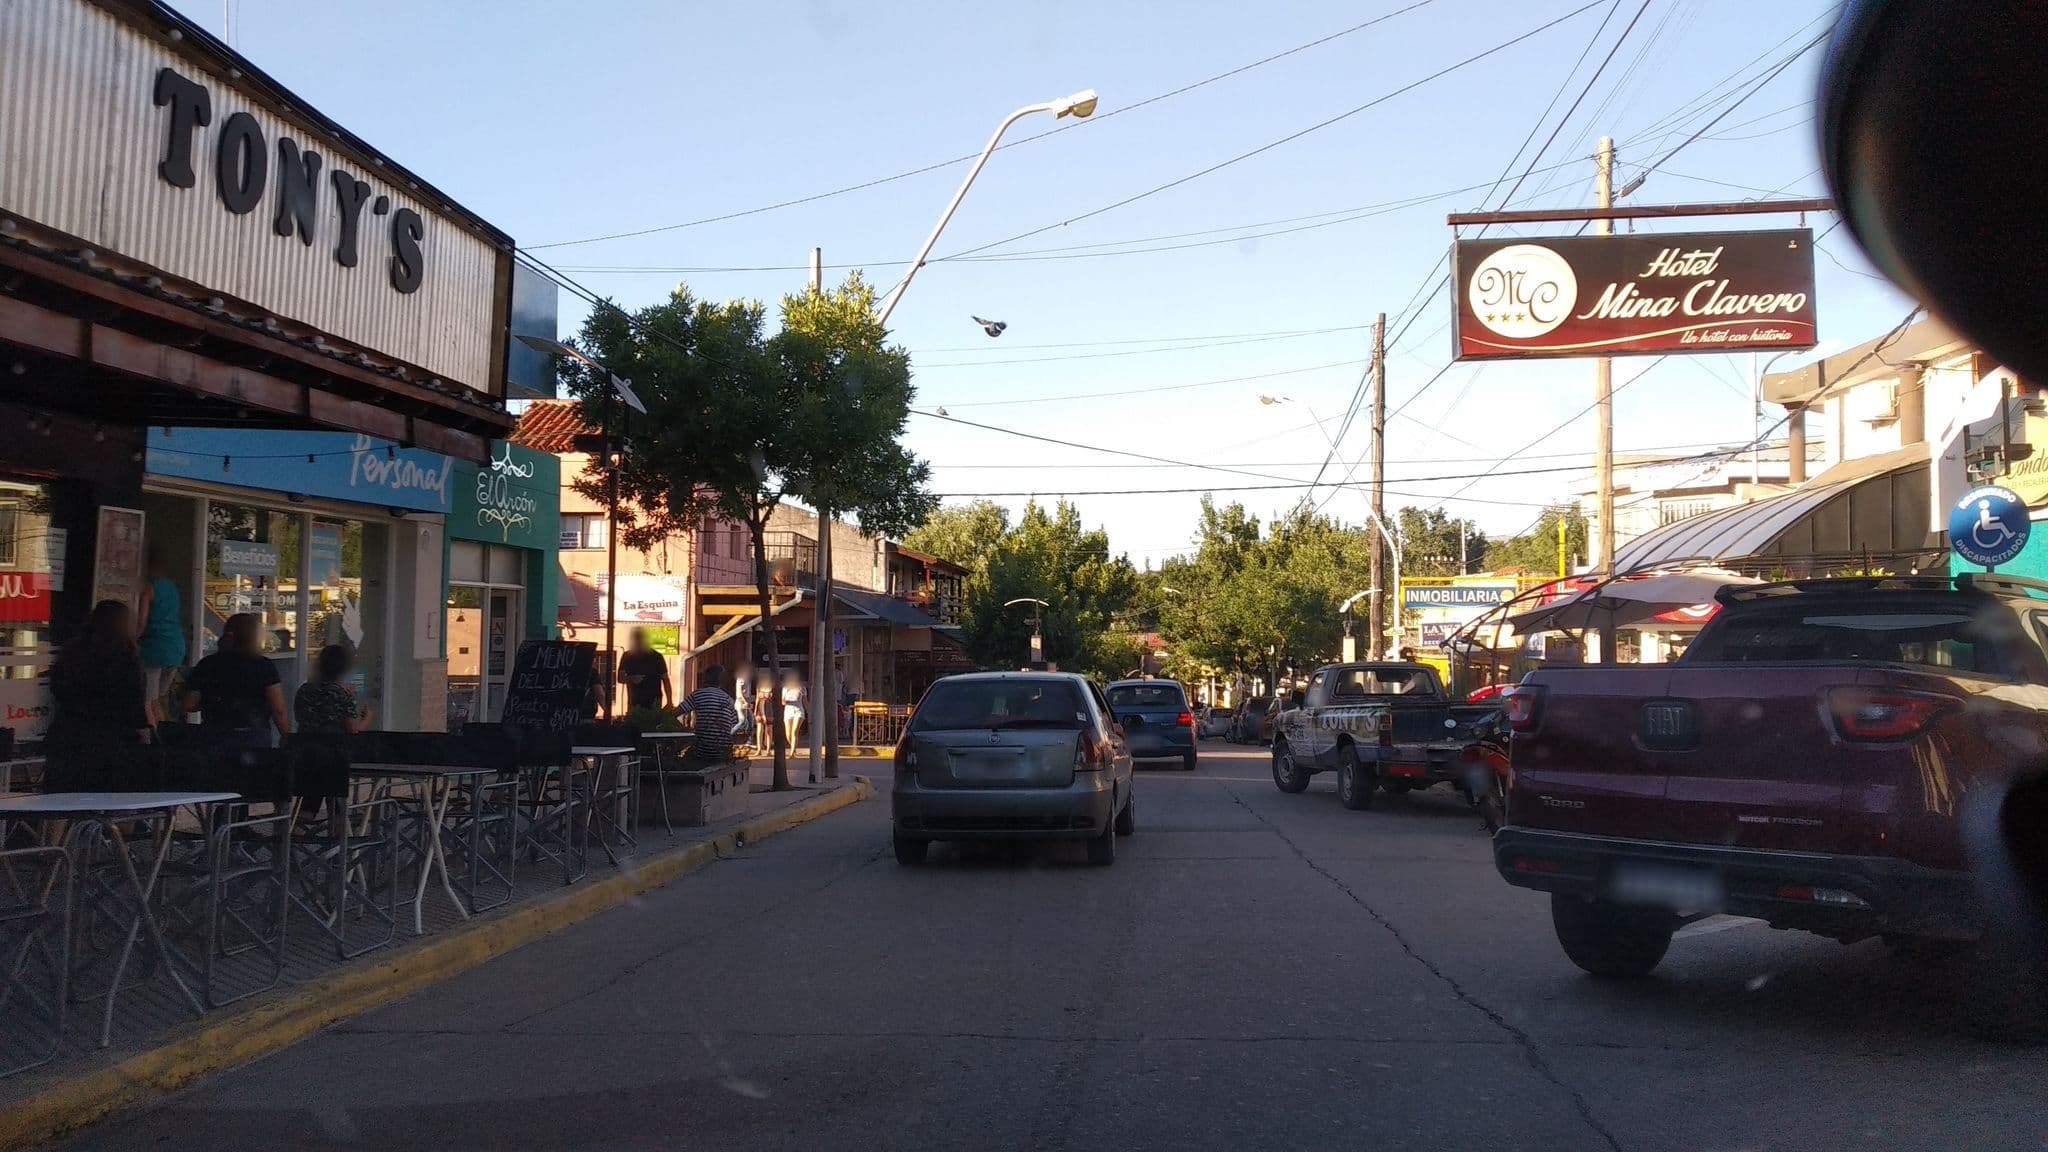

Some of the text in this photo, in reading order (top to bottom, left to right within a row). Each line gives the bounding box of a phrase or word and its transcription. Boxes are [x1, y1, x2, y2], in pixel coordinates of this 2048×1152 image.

[155, 67, 425, 295] TONY'S
[1639, 246, 1724, 278] Hotel
[1577, 279, 1807, 320] Mina Clavero
[1680, 328, 1793, 344] Un hotel con historia
[349, 433, 454, 505] Personal
[476, 471, 537, 513] El Arcón
[223, 545, 277, 567] Beneficios
[1956, 531, 2026, 563] DISCAPACITADOS
[623, 600, 679, 610] La Esquina
[1406, 590, 1500, 603] INMOBILIARIA
[1538, 796, 1585, 809] TORO
